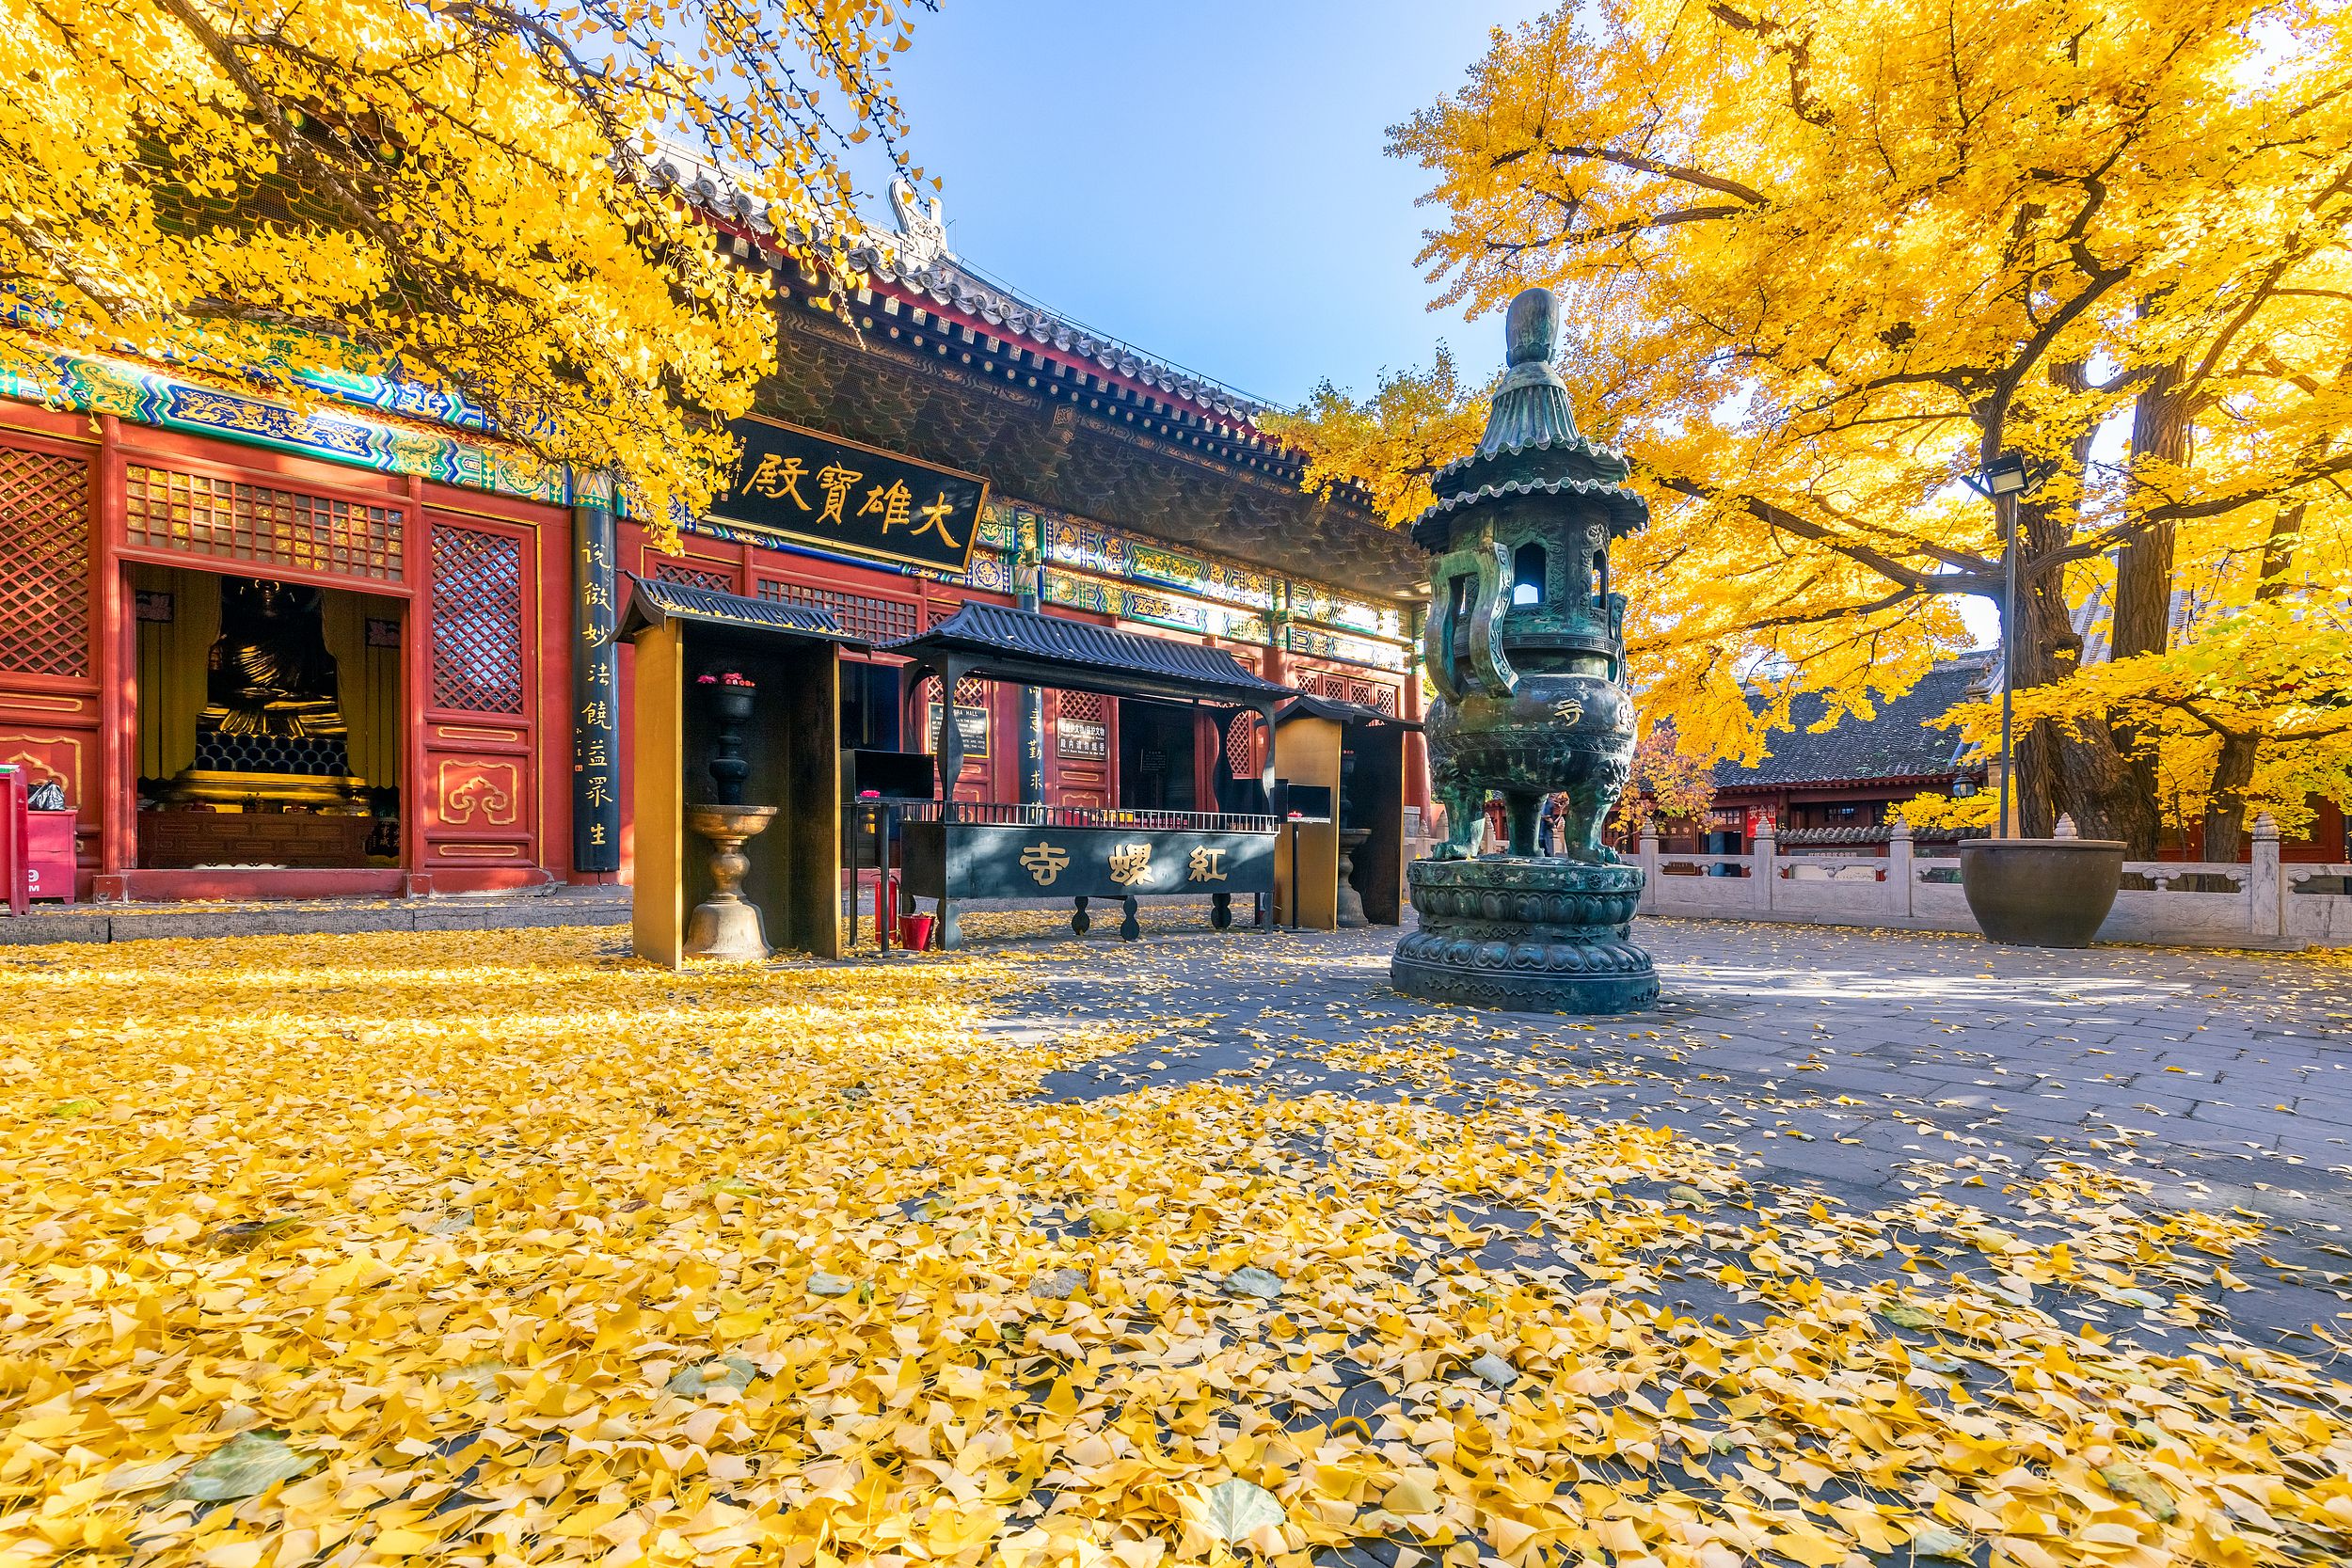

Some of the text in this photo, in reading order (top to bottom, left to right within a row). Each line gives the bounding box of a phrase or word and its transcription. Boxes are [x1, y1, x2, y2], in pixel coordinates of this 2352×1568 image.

[741, 452, 961, 548] 大雄寶殿
[1019, 841, 1228, 887] 紅螺寺
